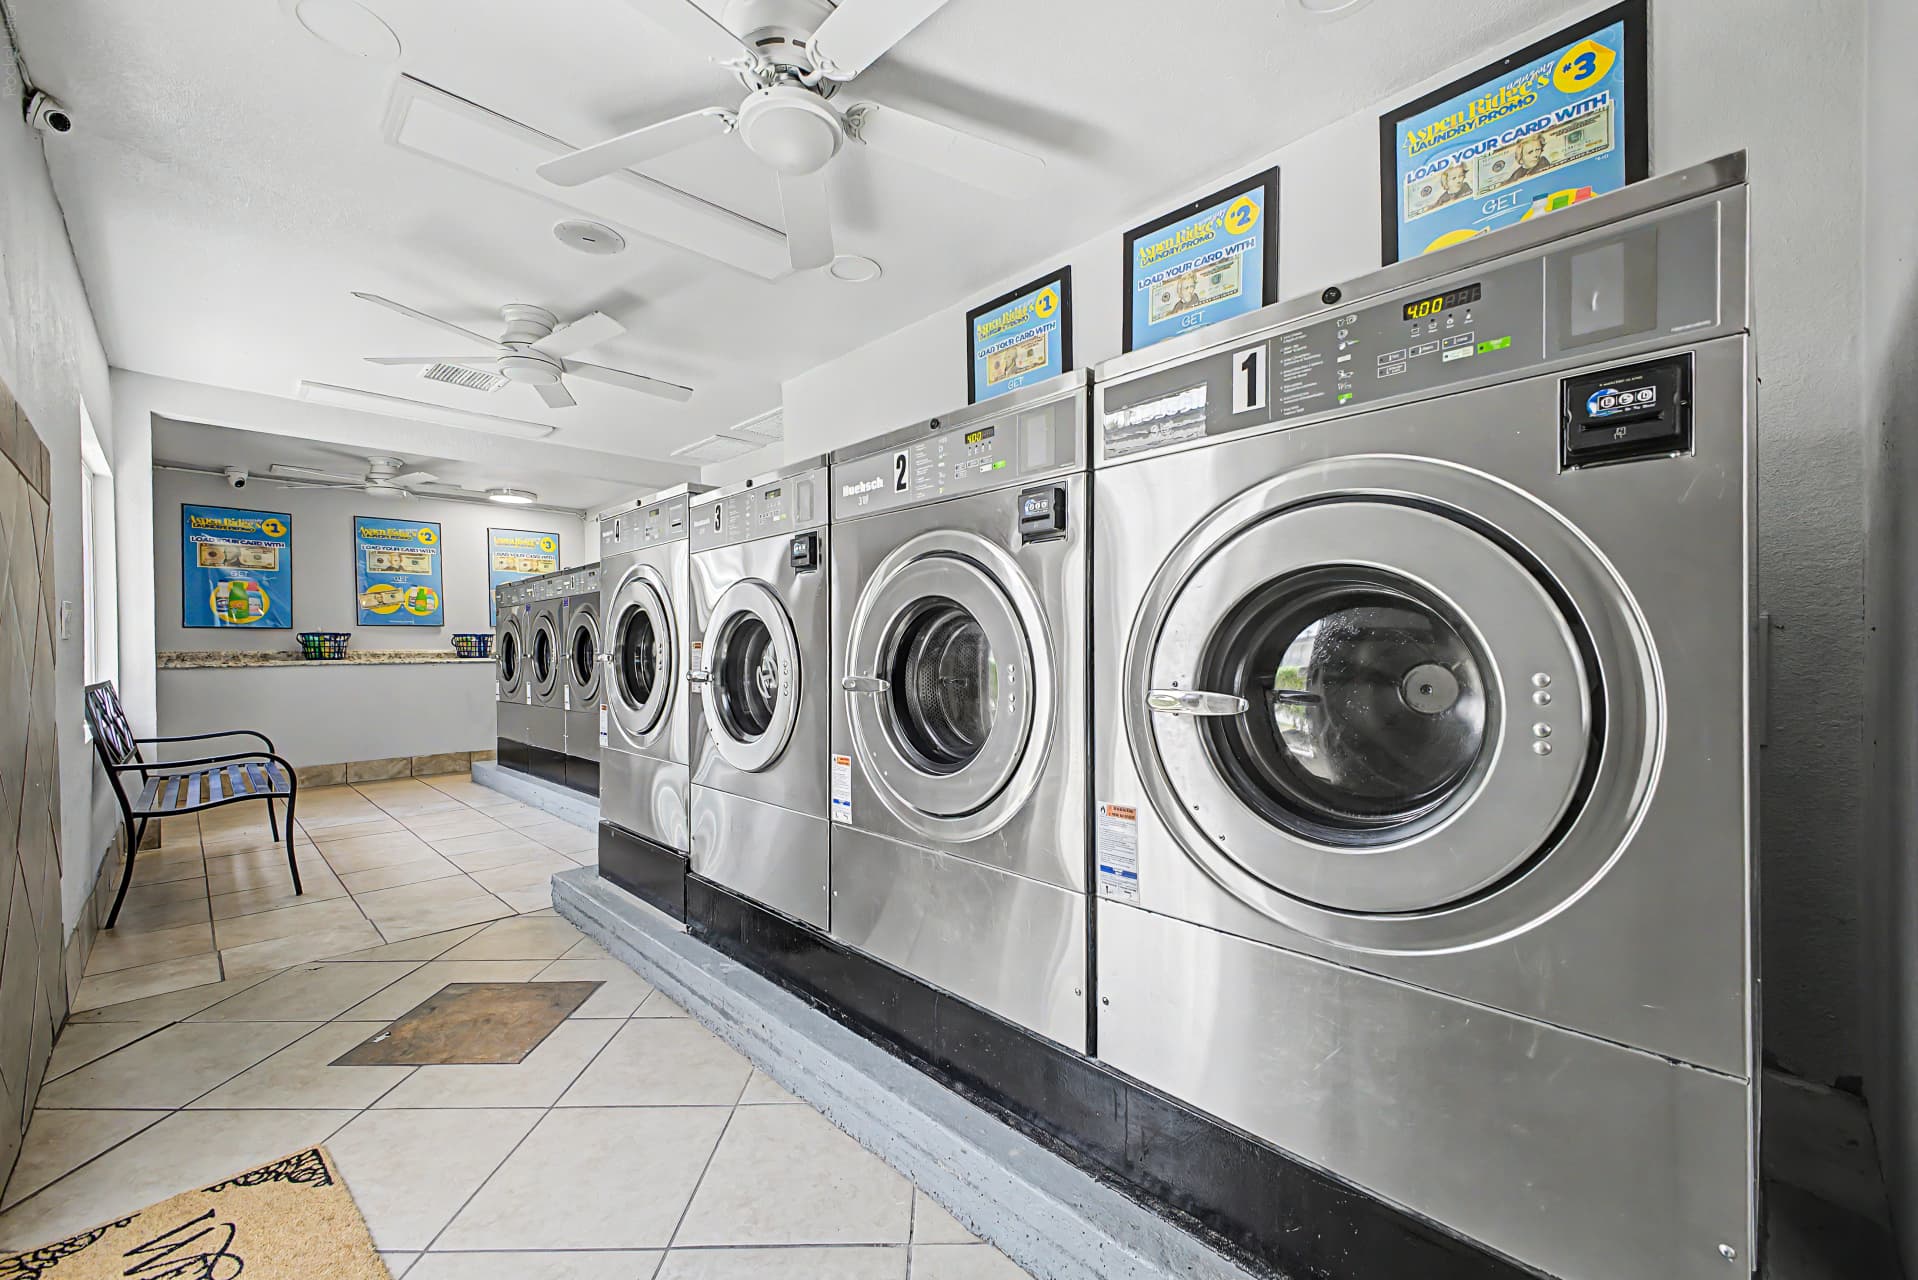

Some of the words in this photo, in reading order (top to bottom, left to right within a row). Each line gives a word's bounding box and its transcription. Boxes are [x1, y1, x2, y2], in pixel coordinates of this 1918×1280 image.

[1562, 52, 1597, 81] #3
[1403, 111, 1464, 147] Aspen
[1407, 159, 1449, 184] LOAD
[1452, 138, 1499, 163] YOUR
[1501, 116, 1552, 144] CARD
[1555, 93, 1607, 124] WITH
[1411, 119, 1476, 154] LAUNDRY
[1479, 94, 1535, 125] PROMO
[1482, 188, 1524, 215] GET
[1181, 231, 1215, 250] PROMO
[1139, 273, 1164, 289] LOAD
[1165, 261, 1192, 276] YOUR
[1194, 251, 1223, 268] CARD
[1225, 238, 1255, 256] WITH
[1181, 311, 1205, 328] GET
[1015, 330, 1035, 342] CARD
[1241, 351, 1258, 408] 1
[896, 454, 907, 490] 2
[714, 504, 721, 532] 3
